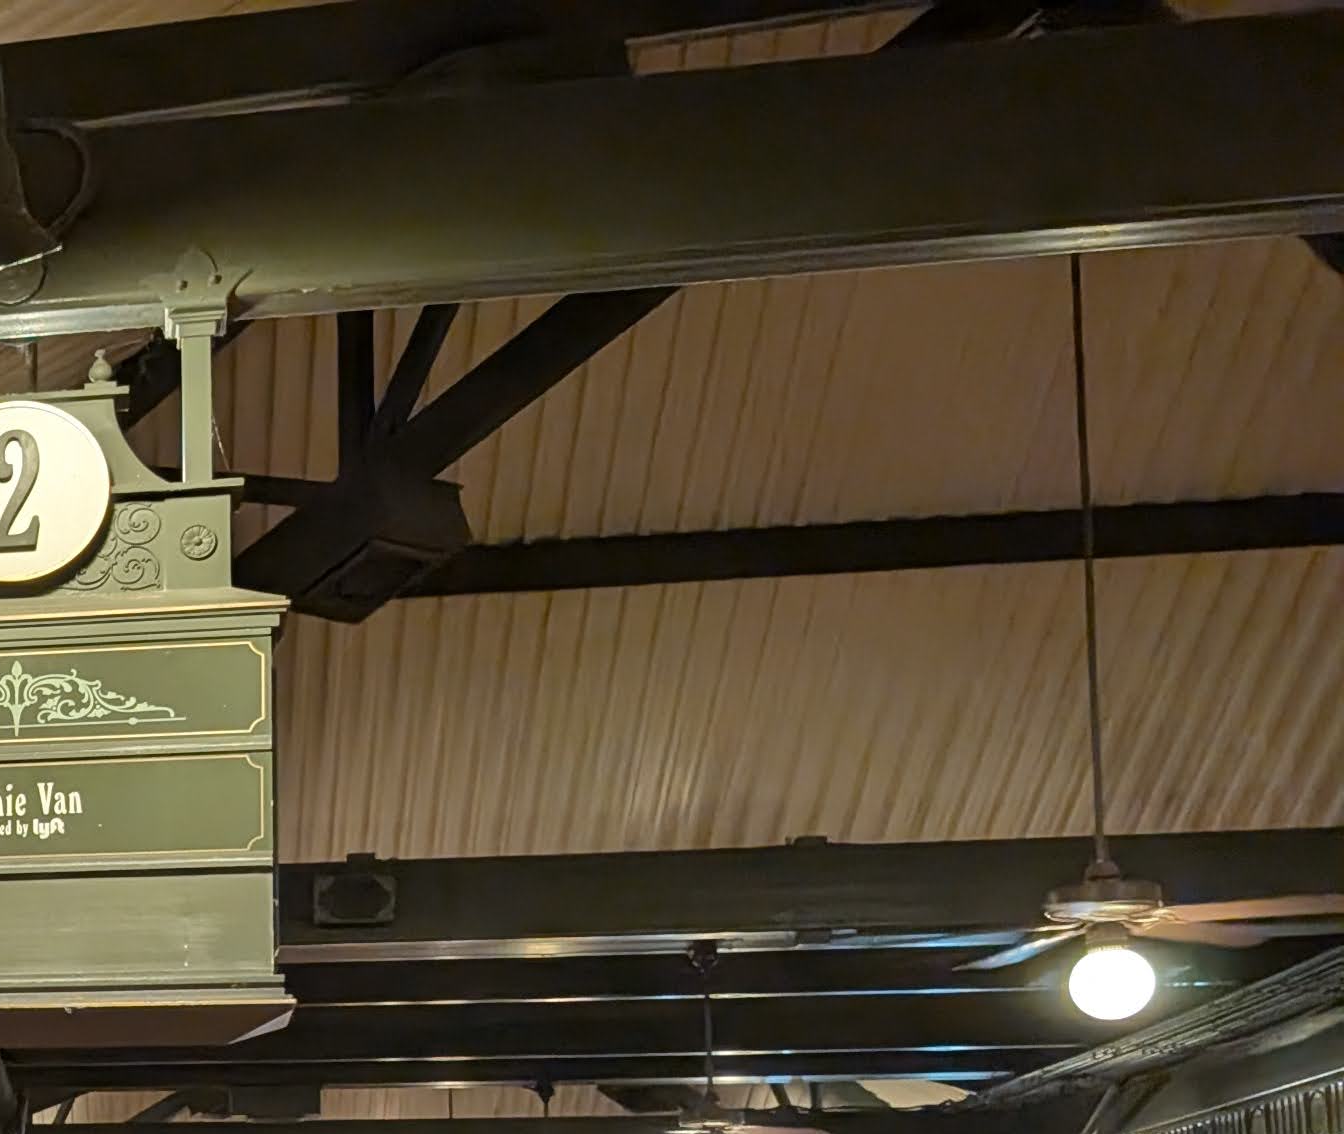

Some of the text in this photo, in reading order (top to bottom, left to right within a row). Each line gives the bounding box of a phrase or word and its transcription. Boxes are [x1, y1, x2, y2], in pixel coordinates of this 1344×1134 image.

[37, 781, 83, 816] Van
[16, 819, 29, 838] by
[32, 817, 65, 840] lyft
